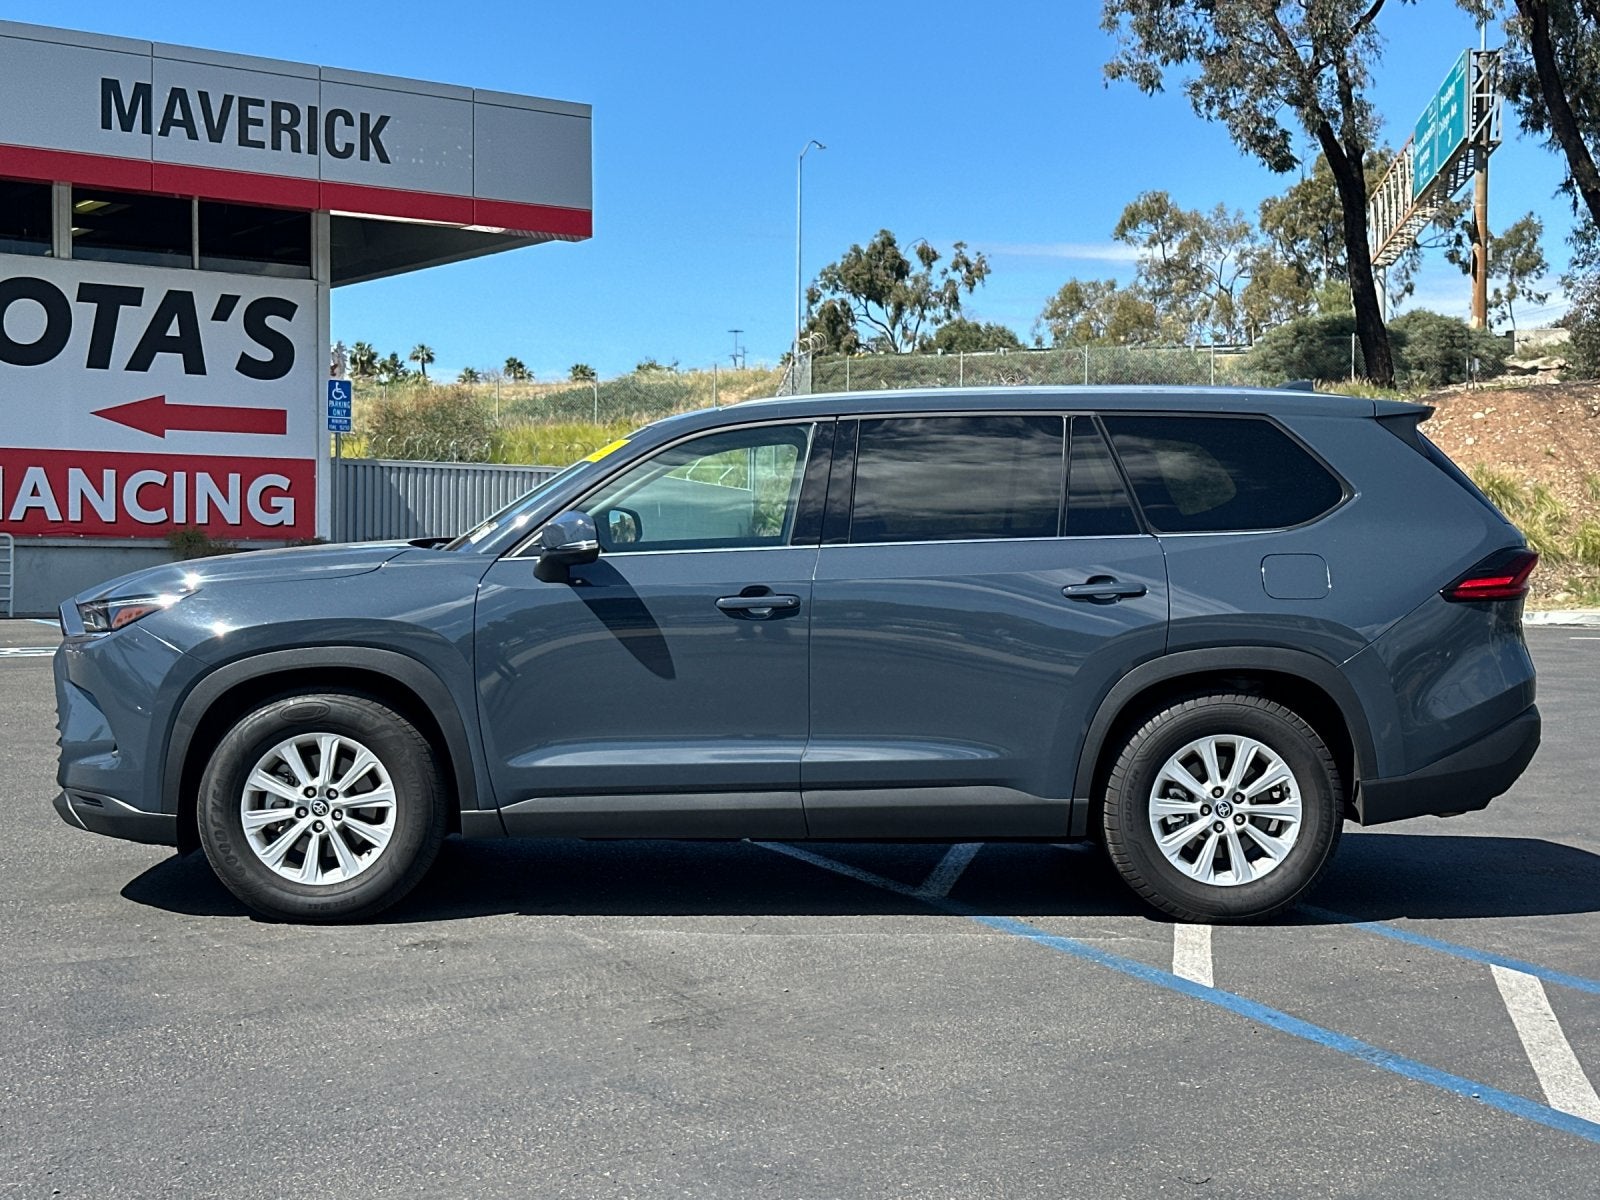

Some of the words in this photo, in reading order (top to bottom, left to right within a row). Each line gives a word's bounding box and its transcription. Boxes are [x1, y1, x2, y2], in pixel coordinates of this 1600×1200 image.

[101, 77, 391, 164] MAVERICK
[0, 276, 299, 381] OTA'S
[329, 400, 350, 408] PARKING
[0, 465, 296, 527] ANCING
